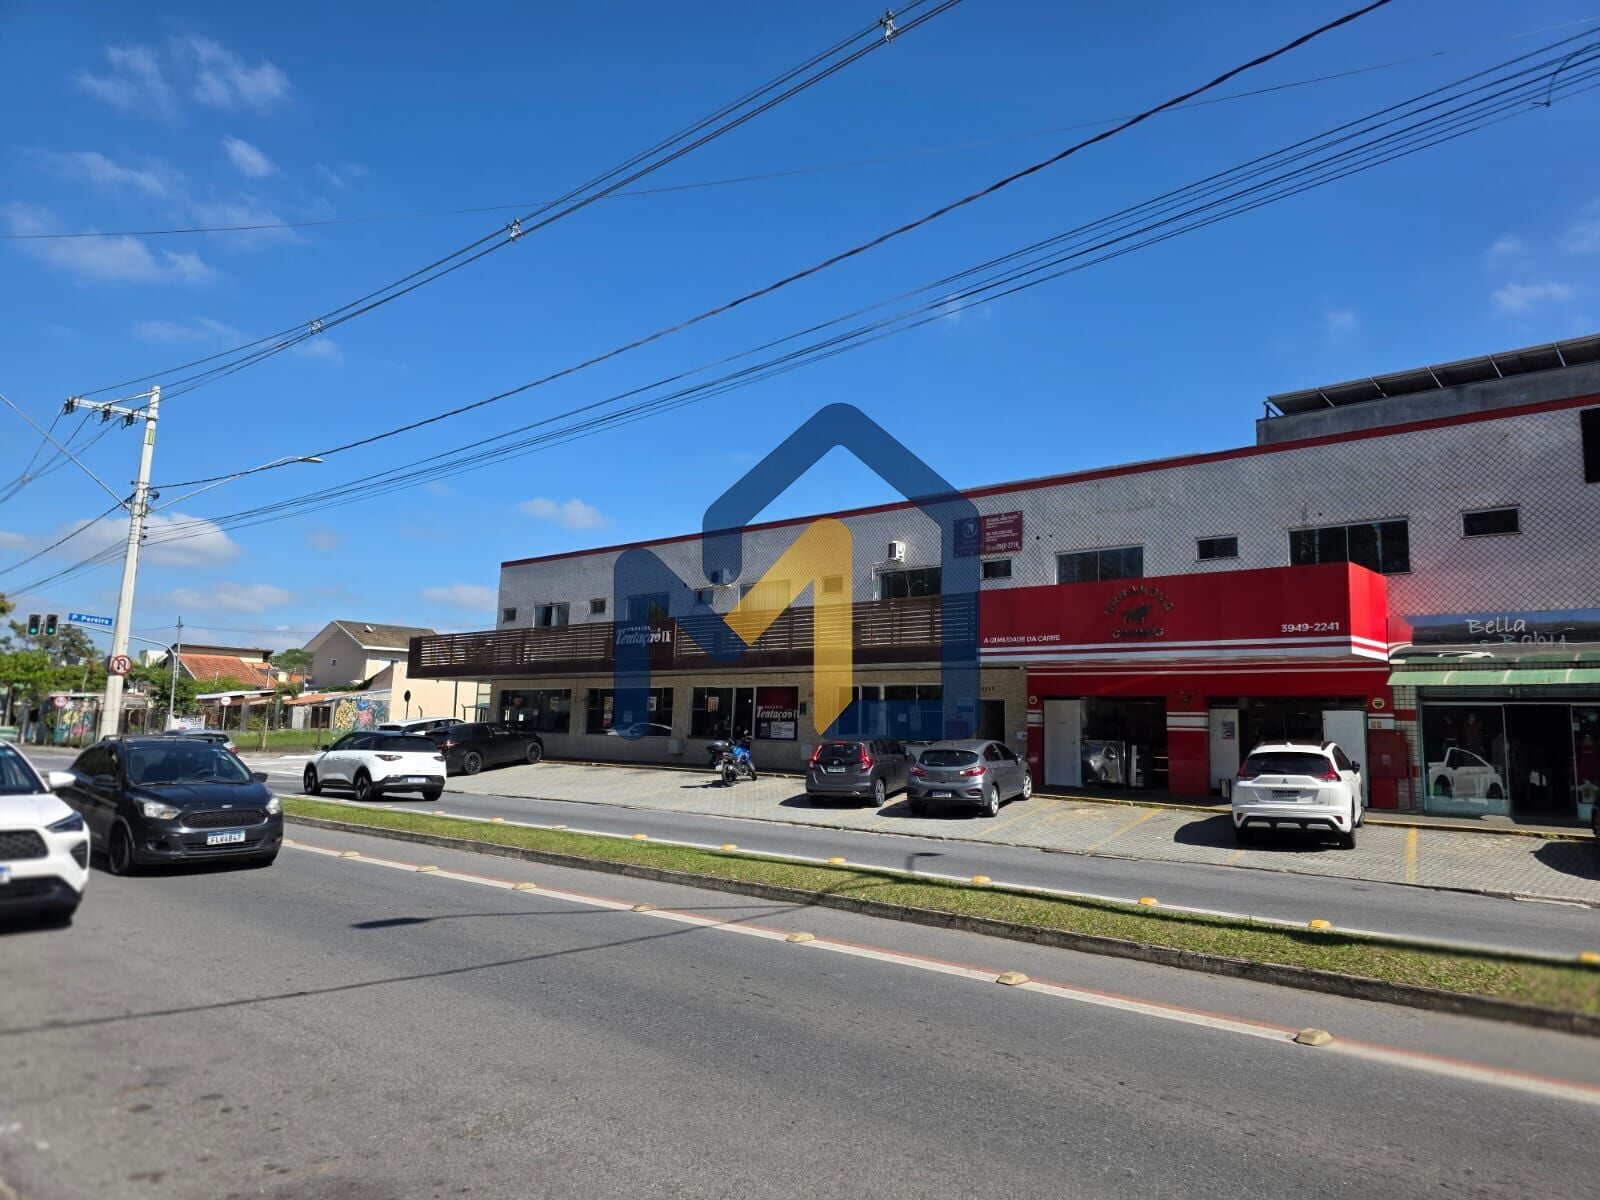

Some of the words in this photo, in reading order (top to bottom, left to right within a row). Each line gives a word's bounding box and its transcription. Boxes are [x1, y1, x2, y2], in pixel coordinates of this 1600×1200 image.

[81, 616, 109, 624] Pereira
[1465, 615, 1526, 634] Bella
[1281, 622, 1340, 633] 3949-2241
[1038, 634, 1060, 642] CARNE
